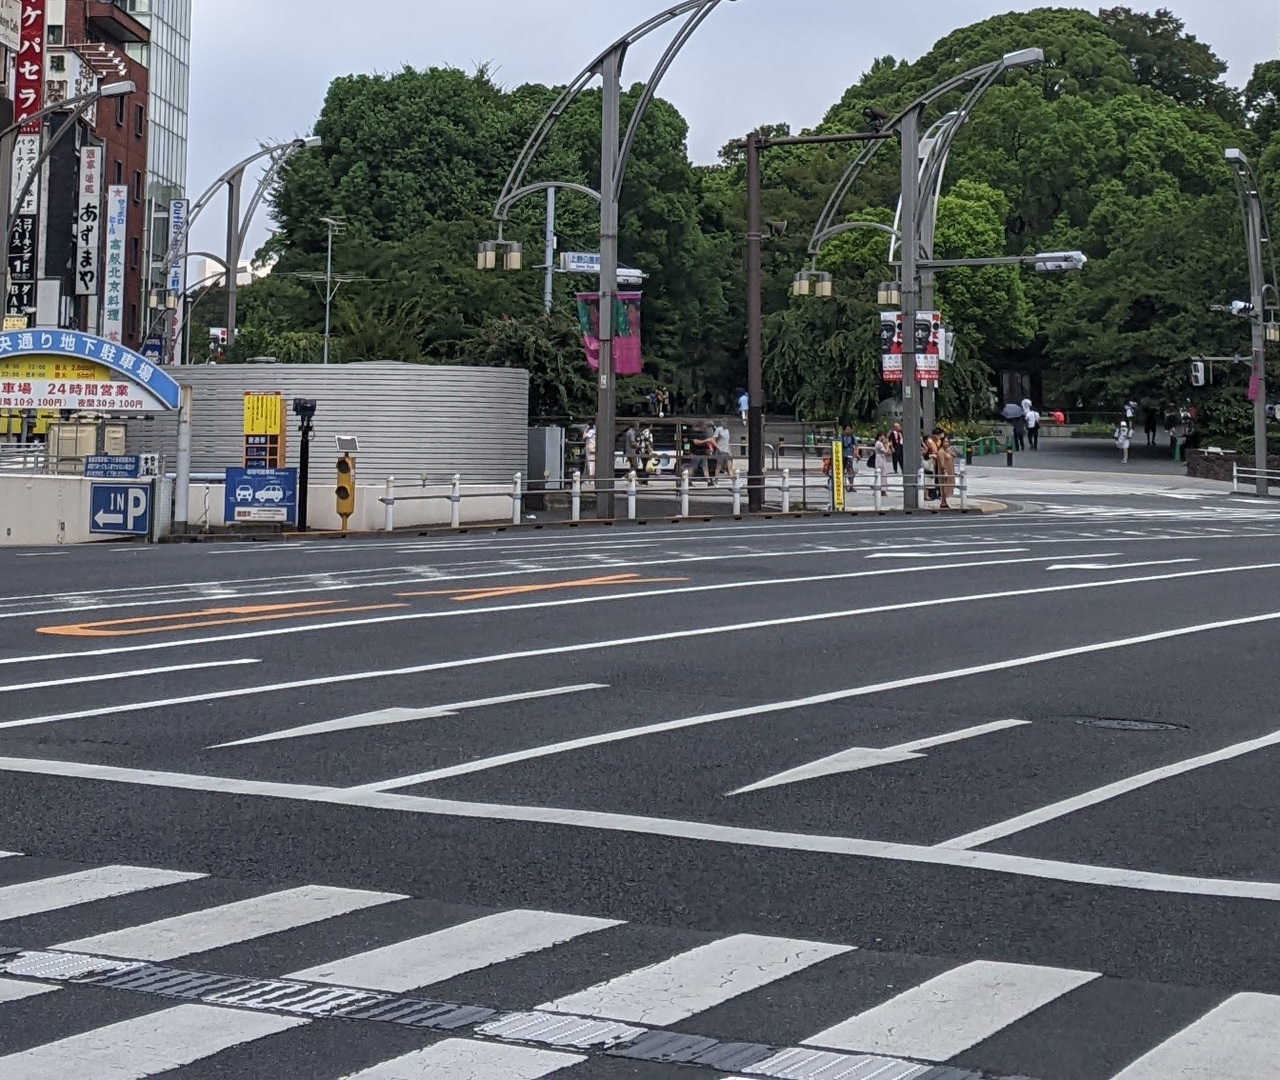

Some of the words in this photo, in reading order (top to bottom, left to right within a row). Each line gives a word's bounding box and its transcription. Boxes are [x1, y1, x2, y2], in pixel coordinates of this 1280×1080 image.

[19, 37, 41, 109] パセラ
[13, 260, 30, 273] 1F
[75, 202, 97, 291] あずまや
[10, 285, 19, 314] BAR
[107, 238, 122, 322] 高級北京料理
[47, 382, 129, 397] 24時間営業
[110, 492, 125, 511] IN
[126, 488, 147, 530] P
